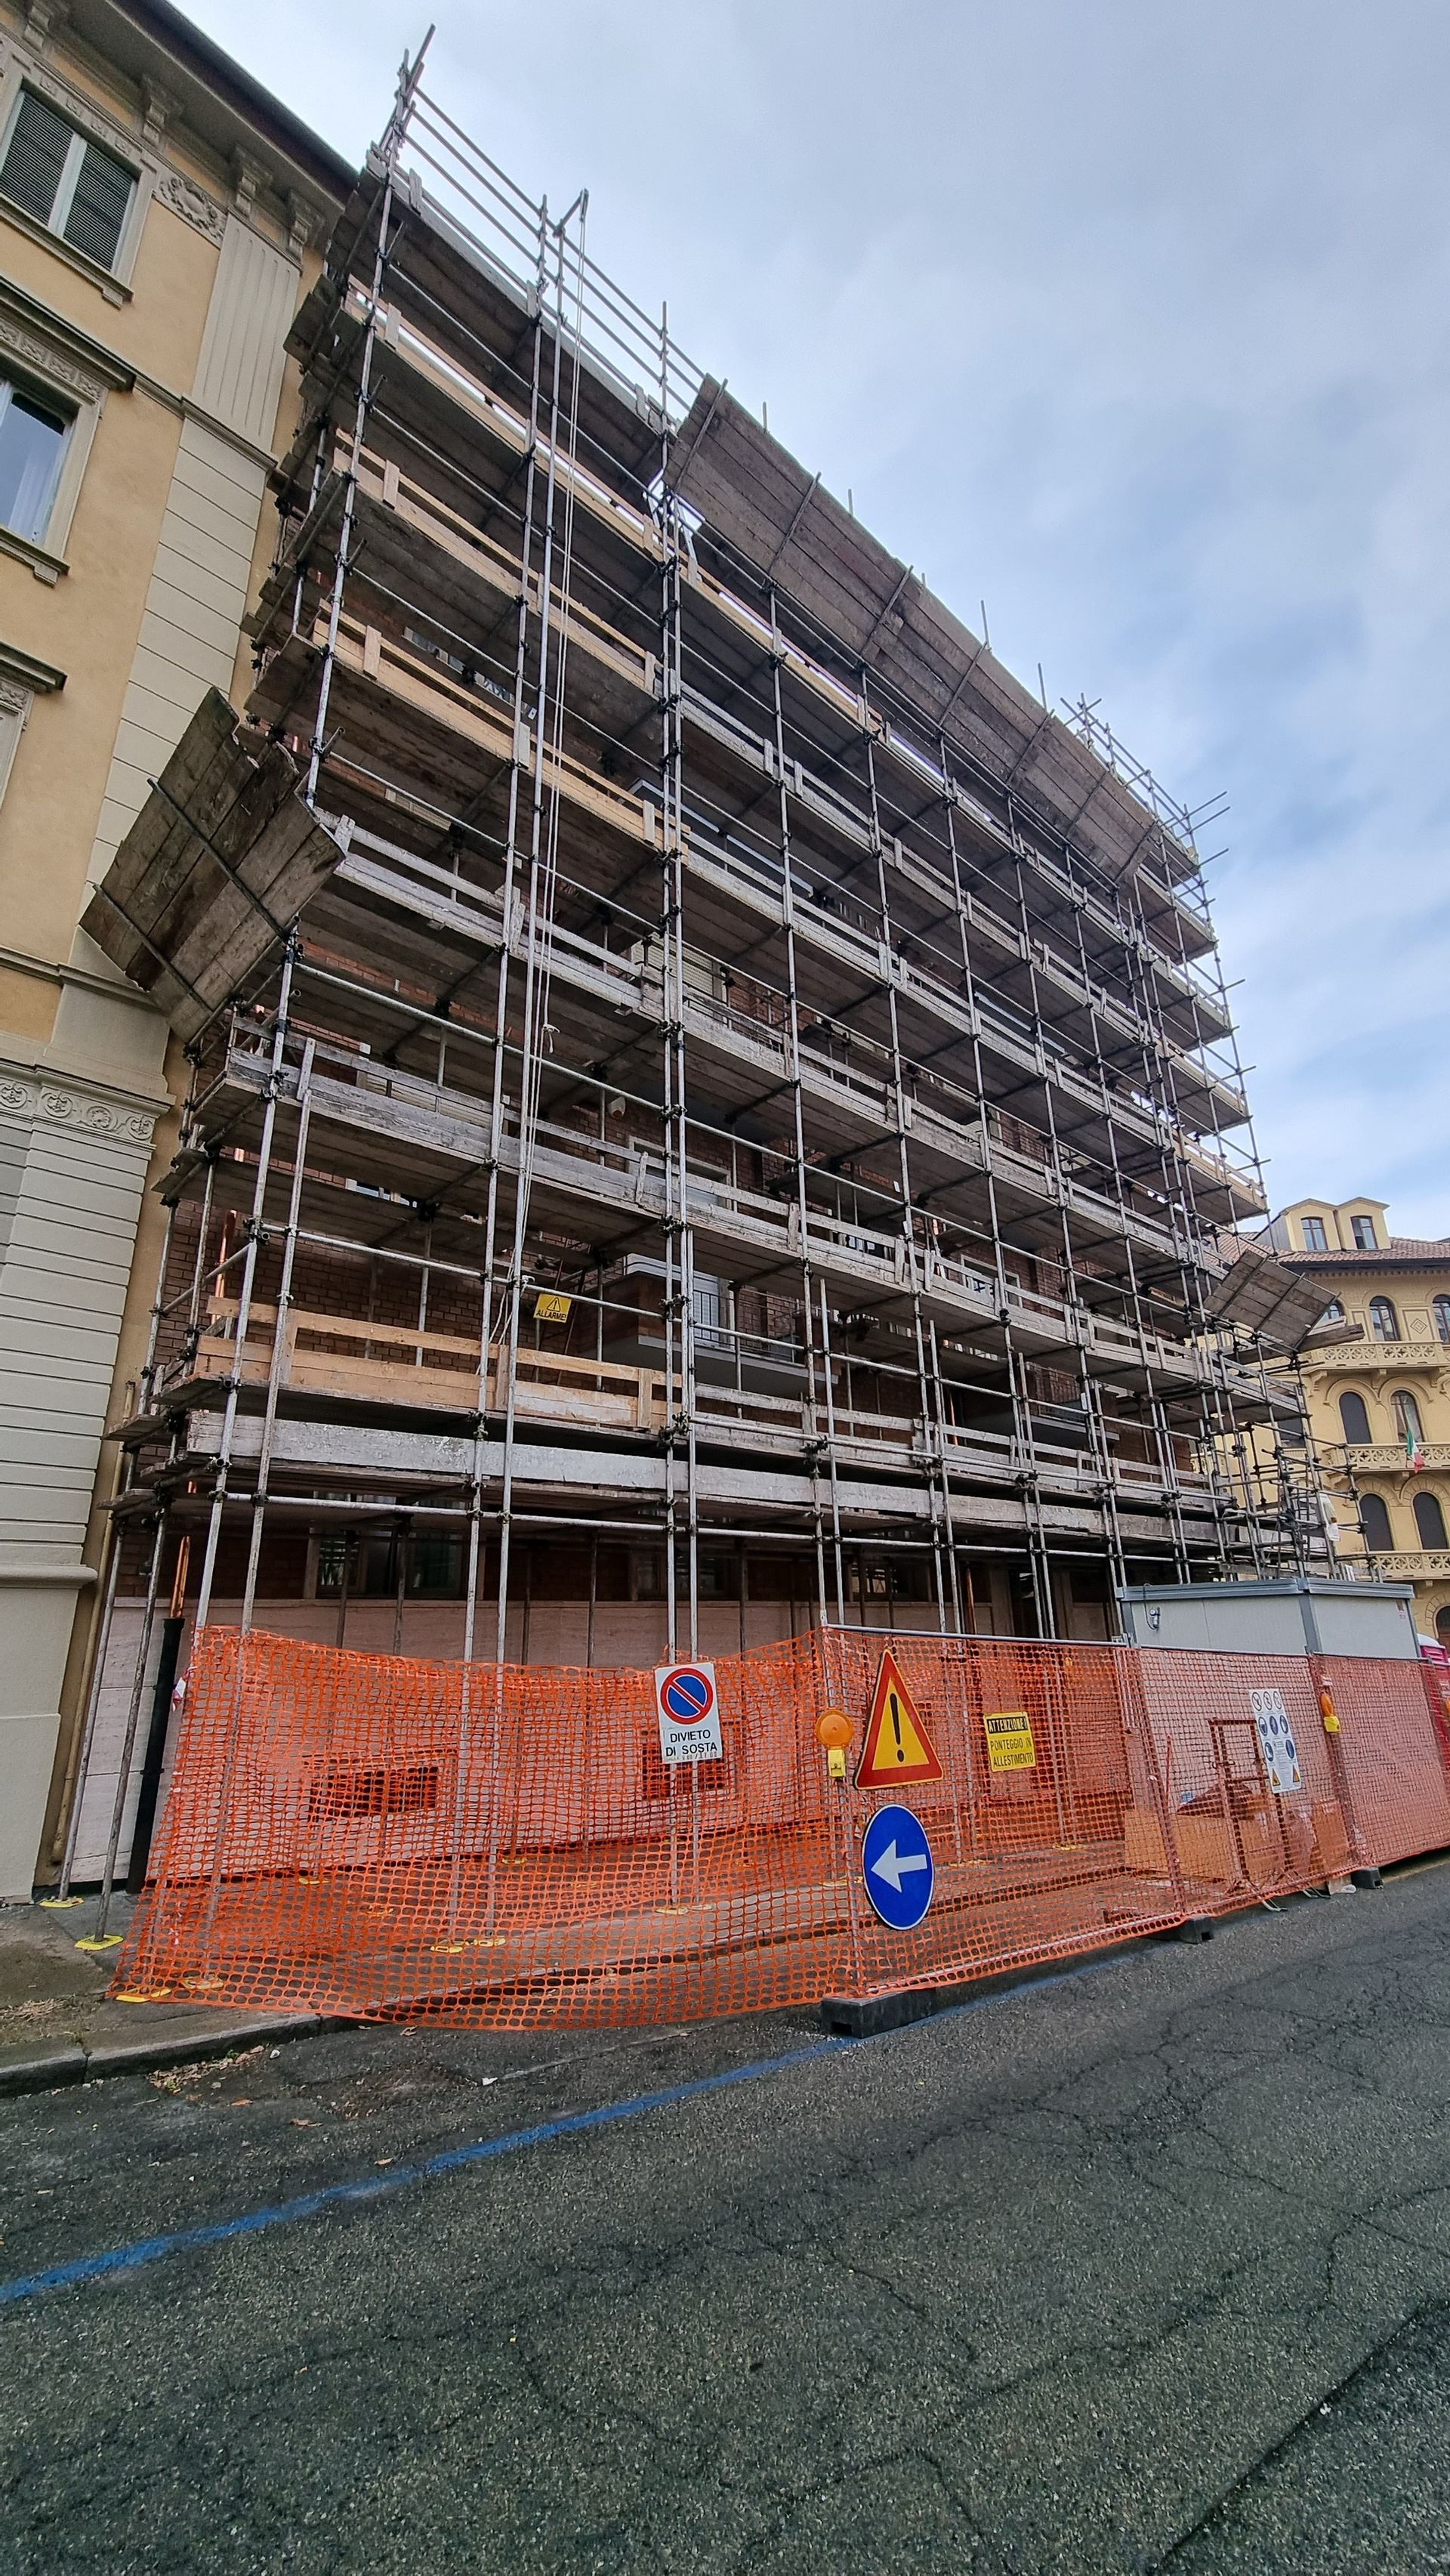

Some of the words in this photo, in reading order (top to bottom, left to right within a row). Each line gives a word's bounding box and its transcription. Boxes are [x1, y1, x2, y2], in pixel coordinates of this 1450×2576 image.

[670, 1729, 711, 1743] DIVIETO
[665, 1747, 676, 1757] DI
[682, 1742, 717, 1755] SOSTA
[990, 1737, 1023, 1751] PONTEGGIO
[1026, 1737, 1032, 1747] IN
[993, 1752, 1034, 1768] ALLESTIMENTO
